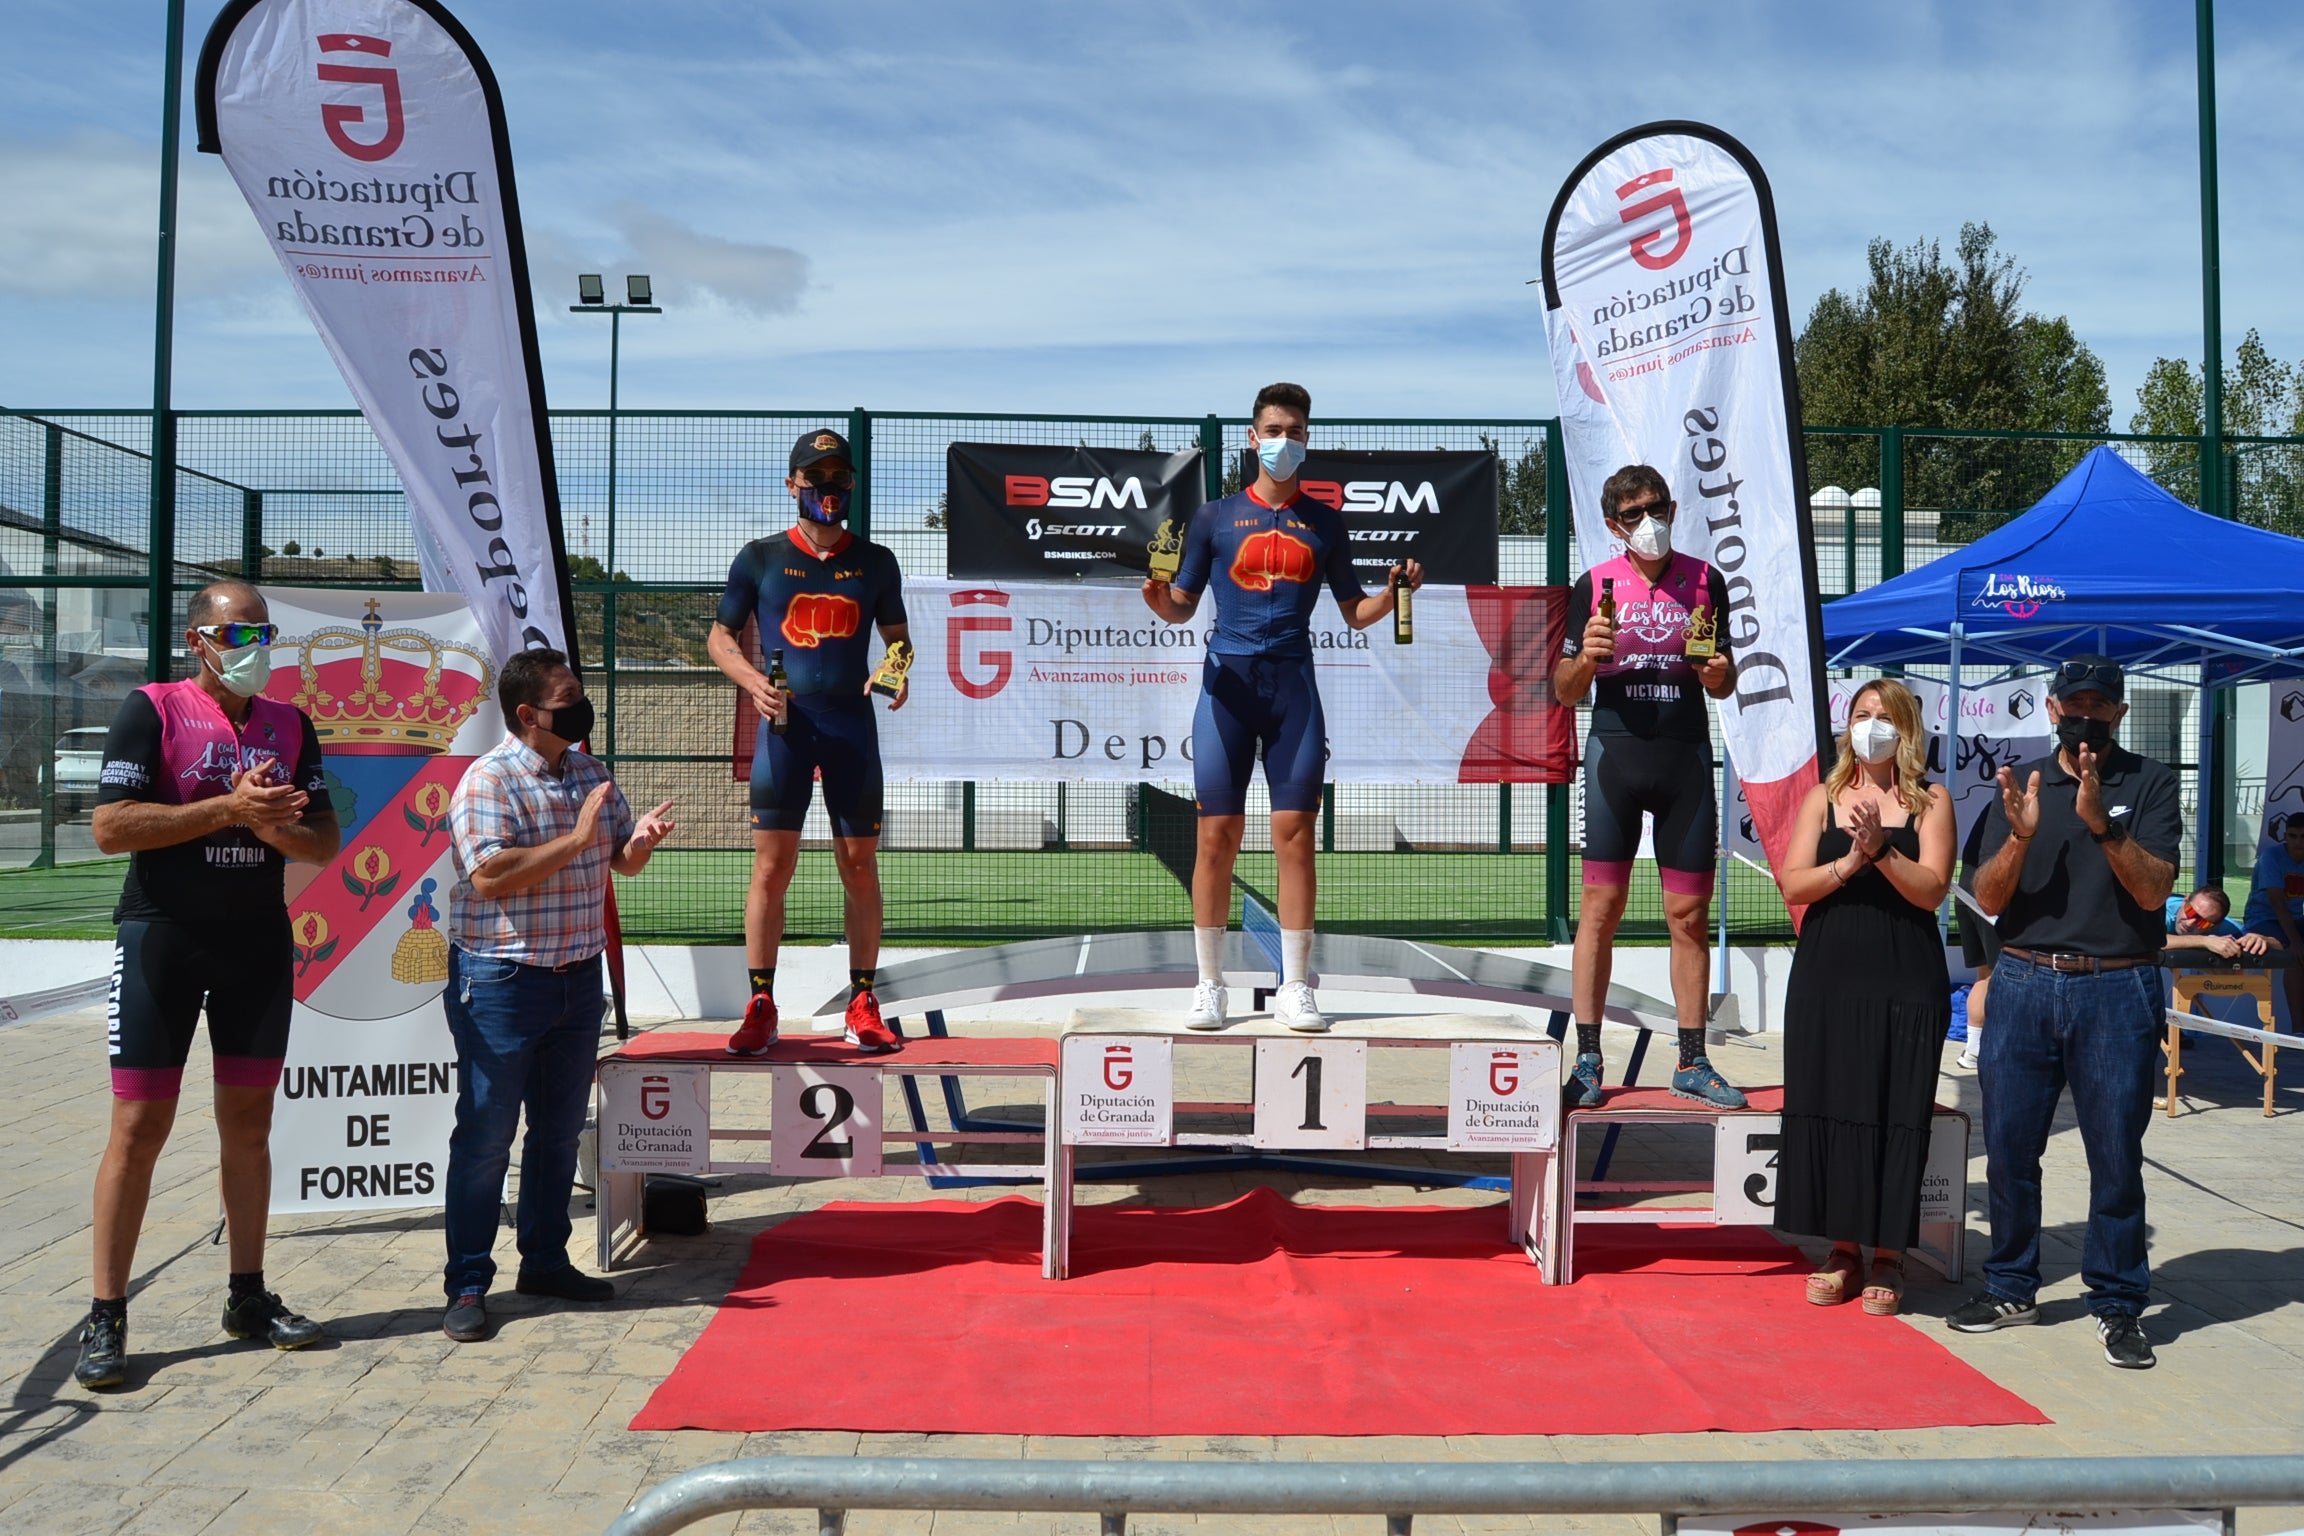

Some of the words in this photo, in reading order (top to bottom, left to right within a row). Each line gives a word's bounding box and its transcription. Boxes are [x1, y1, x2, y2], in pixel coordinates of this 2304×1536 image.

[1005, 474, 1148, 510] BSM
[1043, 524, 1127, 537] SCOTT
[1043, 550, 1117, 560] BSMBIKES.COM
[1981, 573, 2018, 600] Los
[1615, 601, 1651, 625] Los
[1025, 618, 1197, 655] Diputación
[1027, 666, 1125, 684] Avanzamos
[1129, 668, 1188, 686] junt@s
[1625, 684, 1681, 699] VICTORIA
[205, 846, 265, 863] VICTORIA
[1080, 1093, 1155, 1110] Diputación
[1291, 1056, 1328, 1131] 1
[1465, 1099, 1540, 1115] Diputación
[799, 1083, 855, 1160] 2
[1080, 1109, 1096, 1122] de
[1097, 1109, 1155, 1123] Granada
[1465, 1114, 1481, 1127] de
[1482, 1114, 1540, 1128] Granada
[346, 1113, 391, 1148] DE
[617, 1123, 693, 1139] Diputación
[617, 1138, 633, 1152] de
[635, 1138, 693, 1153] Granada
[300, 1161, 436, 1200] FORNES
